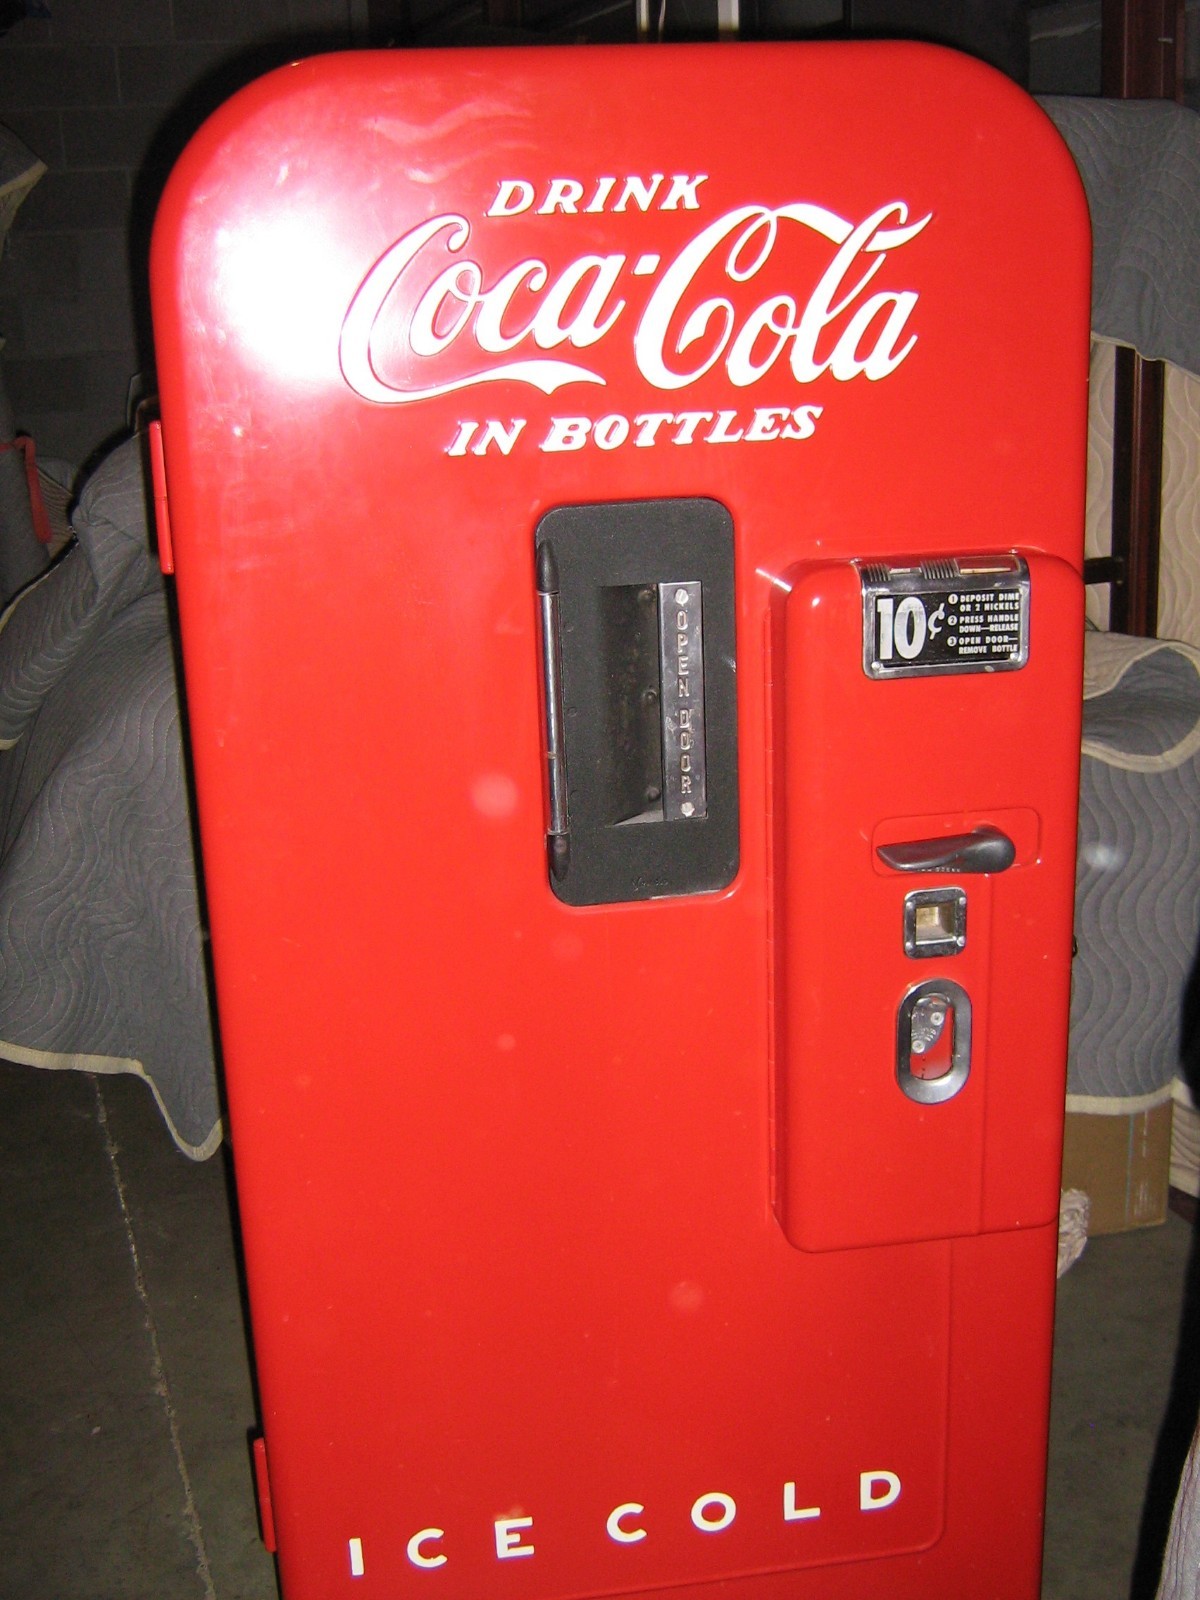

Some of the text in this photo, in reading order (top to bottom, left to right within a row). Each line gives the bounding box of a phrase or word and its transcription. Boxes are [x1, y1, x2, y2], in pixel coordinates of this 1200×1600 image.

[485, 173, 709, 217] DRINK
[338, 200, 934, 404] Coca-Cola
[444, 405, 824, 456] IN BOTTLES
[959, 602, 1019, 612] OR 2 NICKELS
[960, 594, 994, 603] DEPOSIT
[998, 593, 1019, 601] DIME
[959, 615, 985, 624] PRESS
[987, 614, 1019, 623] HANDLE
[958, 636, 981, 645] OPEN
[959, 644, 1018, 654] REMOVE BOTTLE
[676, 610, 693, 795] OPEN DOOR
[349, 1470, 901, 1576] ICE COLD
